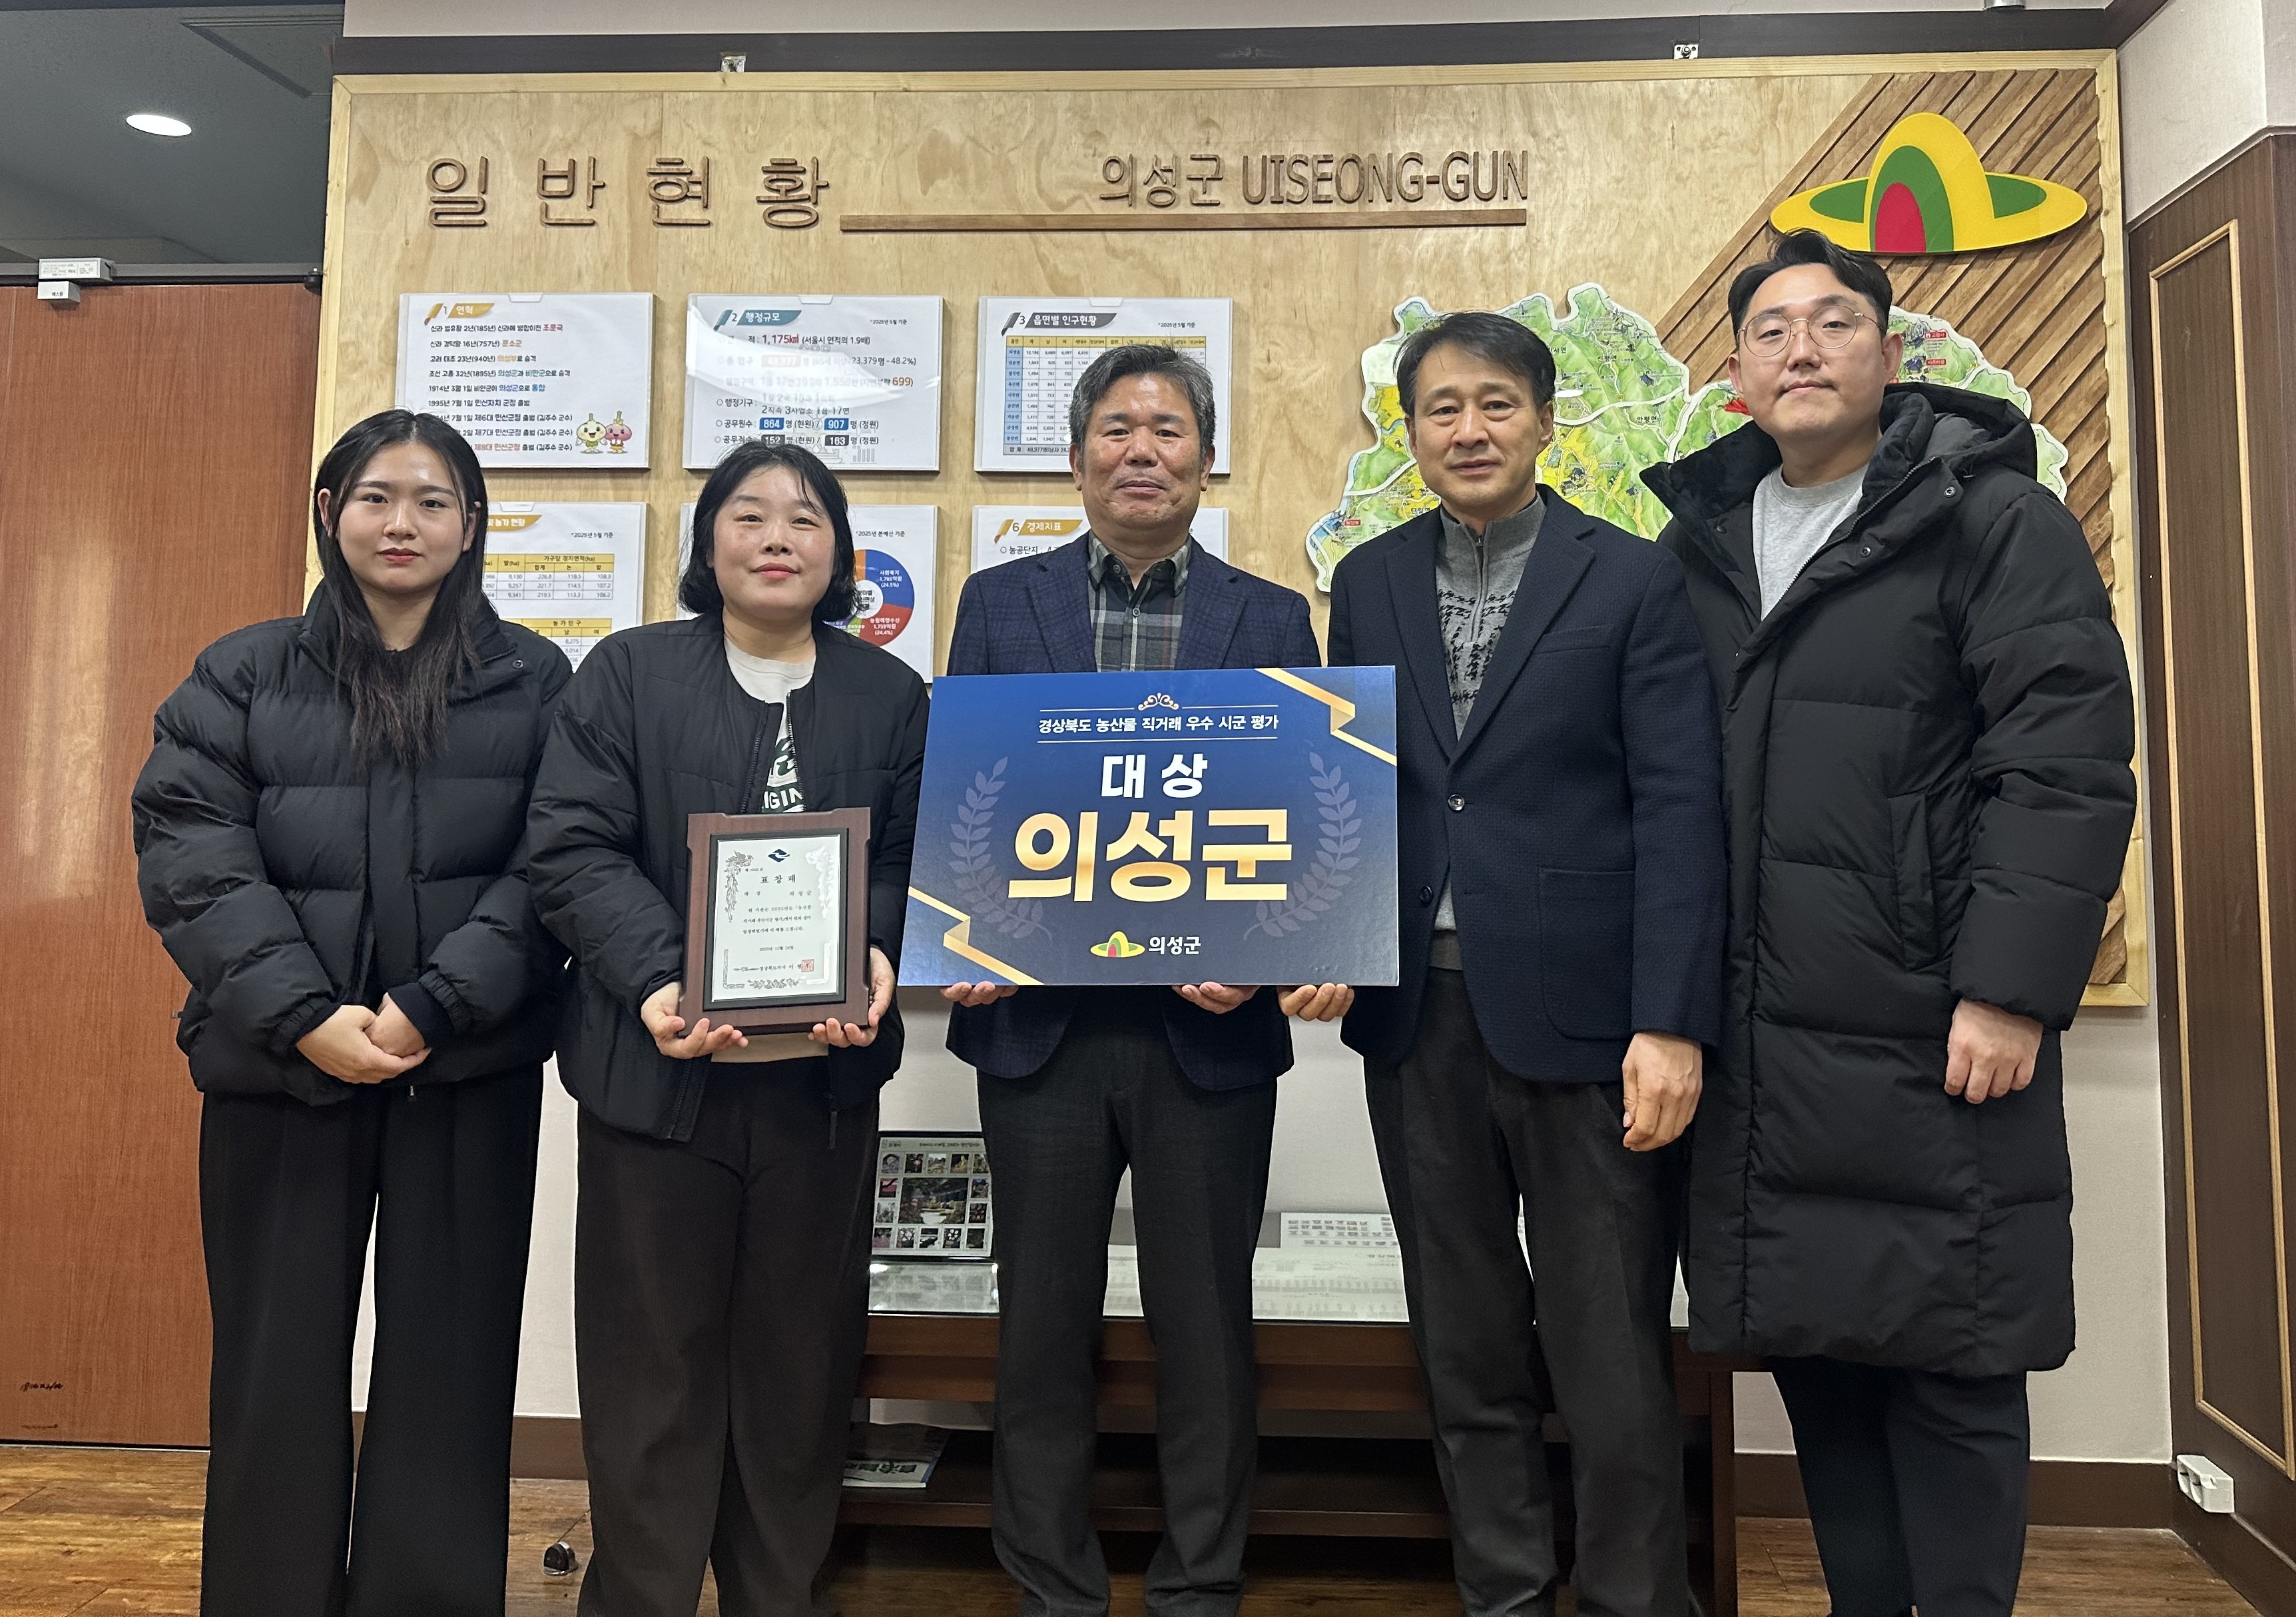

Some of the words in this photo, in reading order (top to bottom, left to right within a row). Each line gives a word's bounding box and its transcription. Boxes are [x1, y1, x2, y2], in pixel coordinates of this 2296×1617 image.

[1099, 153, 1224, 207] 의성군
[1242, 150, 1528, 204] UISEONG-GUN
[456, 306, 473, 315] 연혁
[732, 313, 737, 322] 2
[746, 312, 780, 322] 행정규모
[1019, 316, 1025, 324] 3
[1033, 315, 1059, 326] 읍면별
[1062, 315, 1097, 326] 인구현황
[891, 357, 916, 366] 48.2%)
[892, 377, 913, 387] 699)
[724, 420, 752, 429] 공무원수
[764, 420, 780, 429] 864
[786, 420, 792, 429] 명
[828, 420, 844, 429] 907
[850, 420, 857, 429] 명
[860, 420, 879, 429] (정원)
[1013, 523, 1019, 531] 6
[1027, 522, 1061, 533] 경제지표
[1039, 717, 1091, 734] 경상북도
[1096, 717, 1137, 733] 농산물
[1141, 717, 1182, 732] 직거래
[1186, 716, 1214, 732] 우수
[1218, 715, 1246, 731] 시군
[1251, 714, 1279, 731] 평가
[1007, 808, 1292, 902] 의성군
[1148, 935, 1201, 955] 의성군
